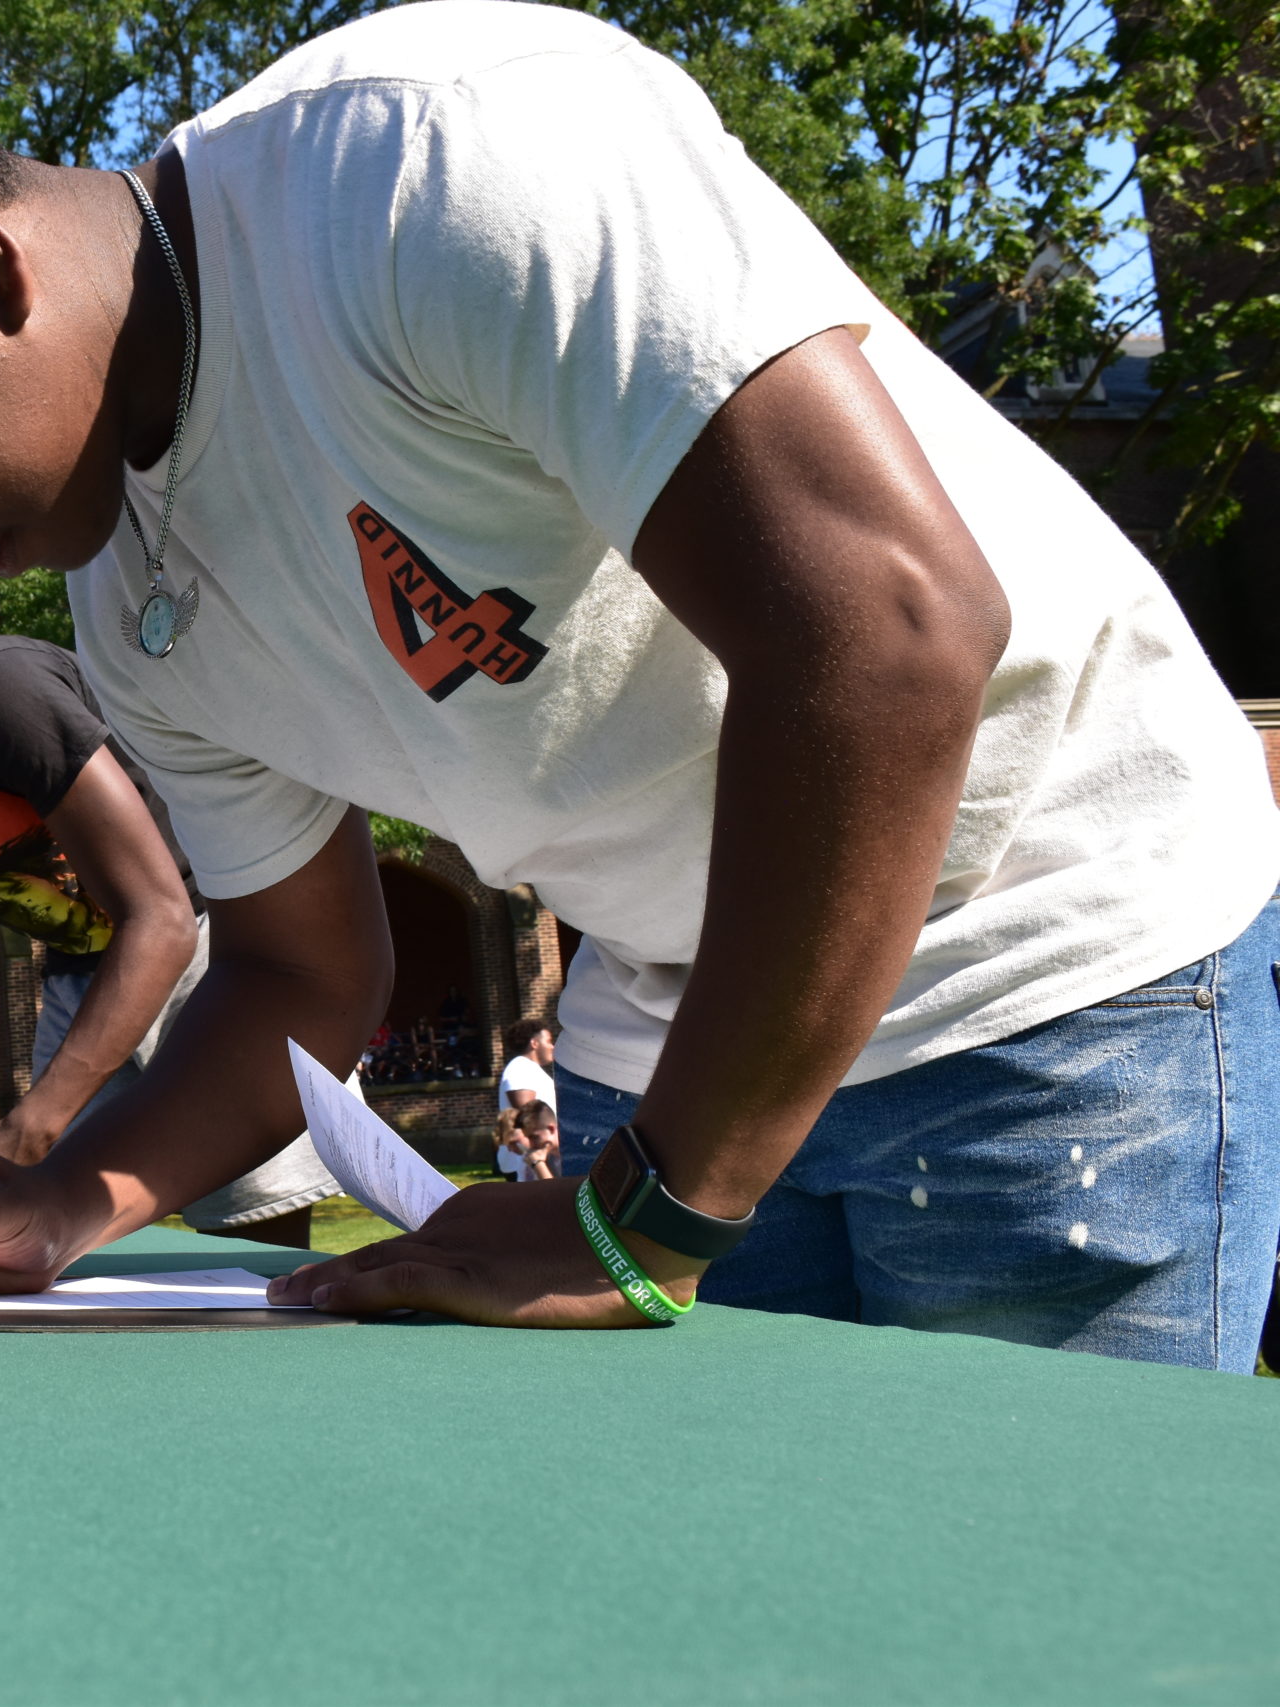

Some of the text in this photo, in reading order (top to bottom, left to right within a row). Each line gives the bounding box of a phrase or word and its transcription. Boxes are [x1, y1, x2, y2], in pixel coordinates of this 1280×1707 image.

[356, 513, 520, 678] HUNNID
[578, 1195, 628, 1275] SUBSTITUTE
[621, 1269, 652, 1305] FOR
[644, 1298, 675, 1321] HAR
